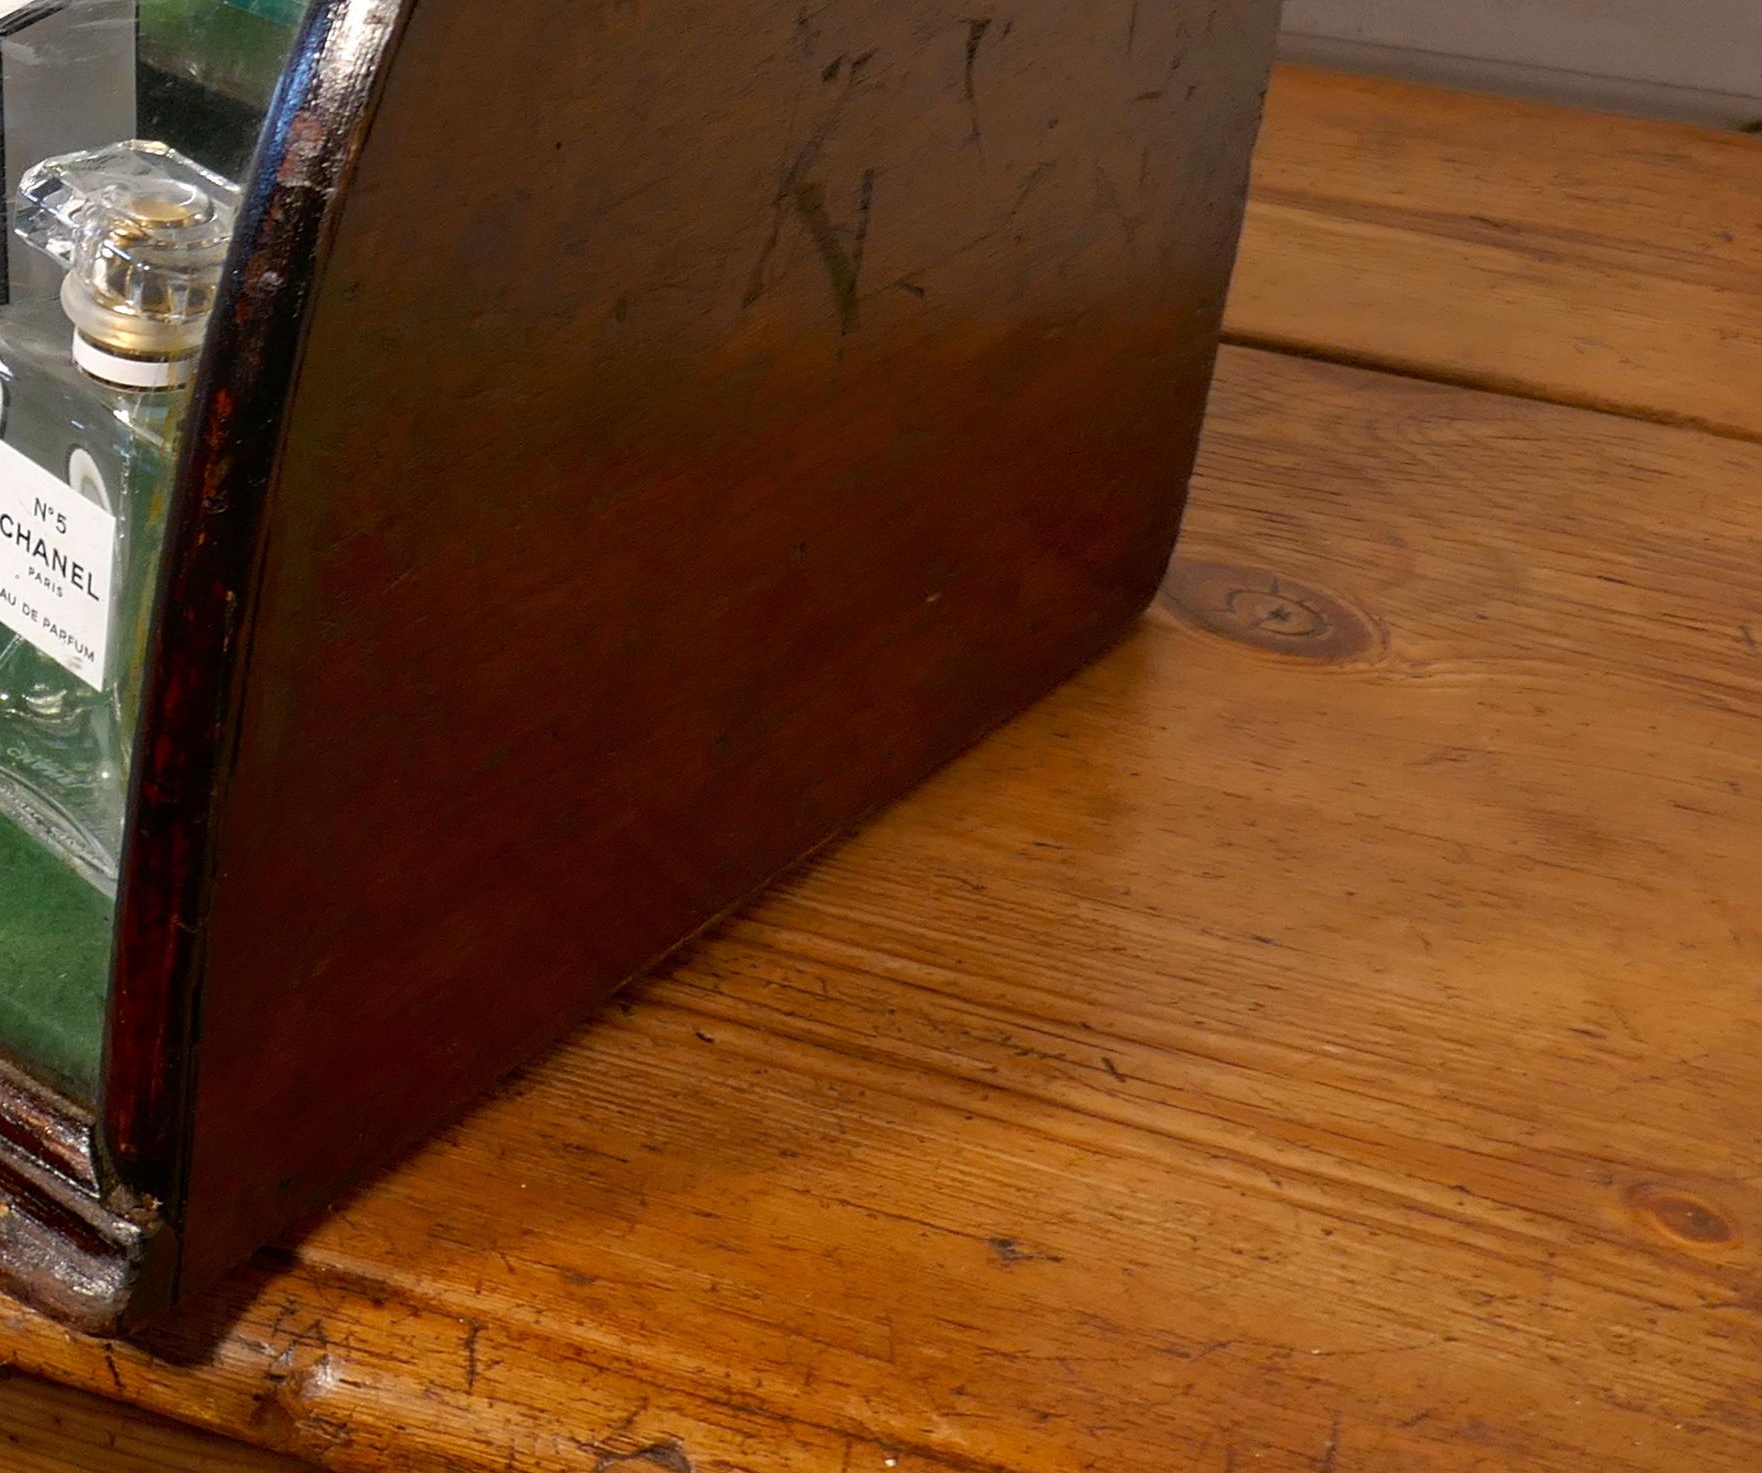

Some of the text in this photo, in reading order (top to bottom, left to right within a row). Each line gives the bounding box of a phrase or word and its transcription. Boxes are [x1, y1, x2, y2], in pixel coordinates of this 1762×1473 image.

[0, 513, 99, 601] CHANEL
[28, 566, 63, 598] PARIS
[22, 602, 39, 622] DE
[42, 616, 95, 663] PARFUM
